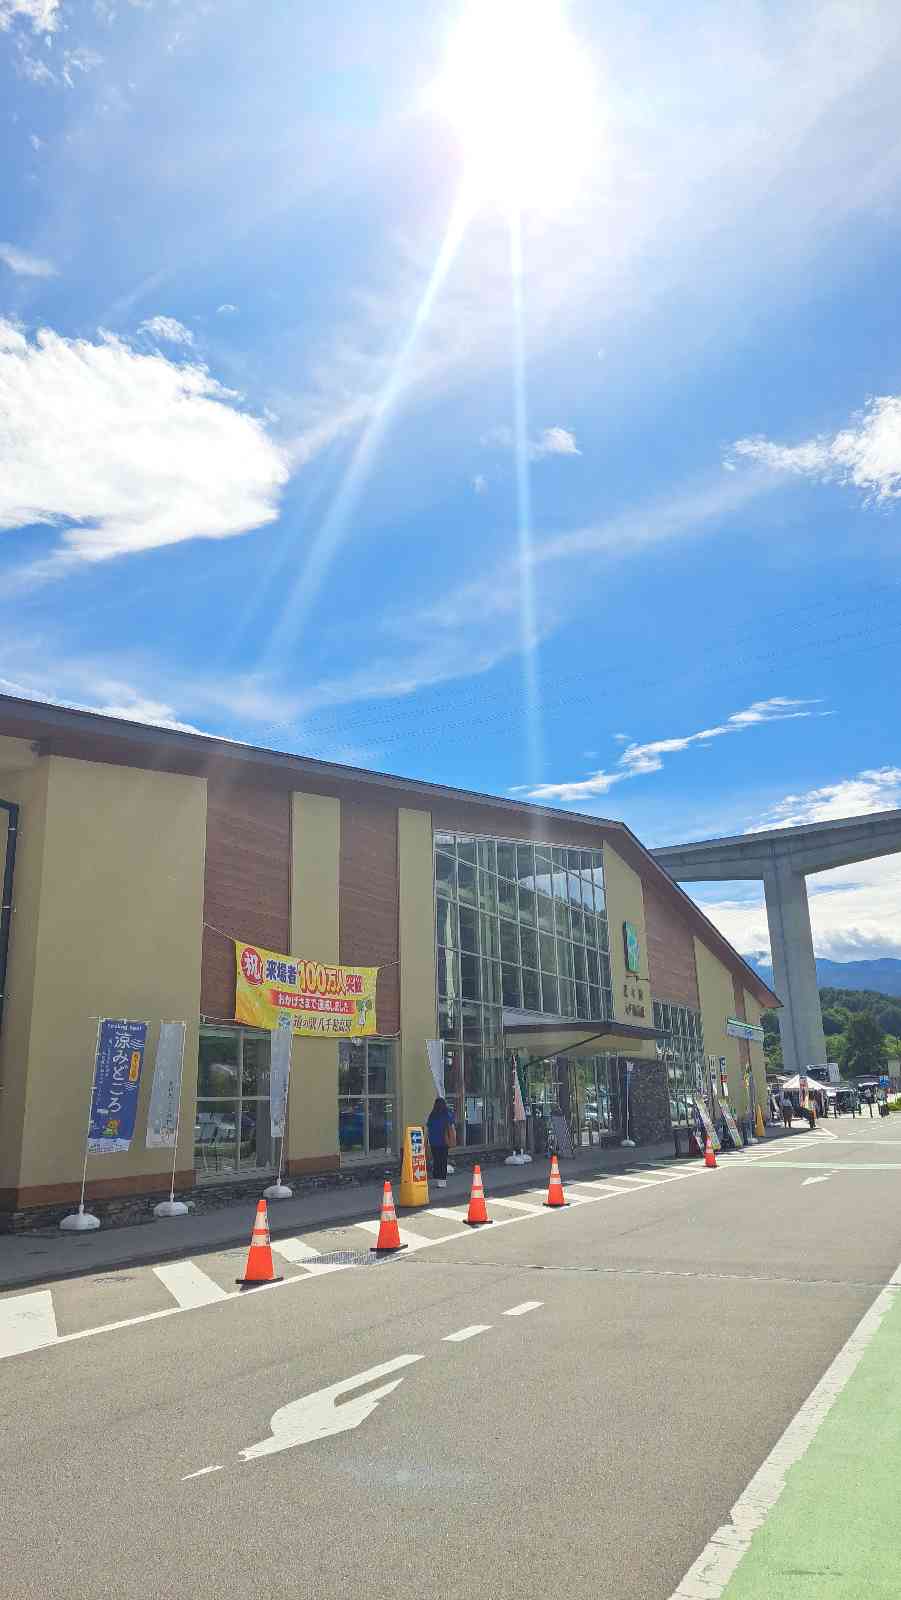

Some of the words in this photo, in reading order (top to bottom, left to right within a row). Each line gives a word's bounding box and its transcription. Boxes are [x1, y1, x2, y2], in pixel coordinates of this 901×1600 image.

[108, 1031, 130, 1113] 涼みどころ
